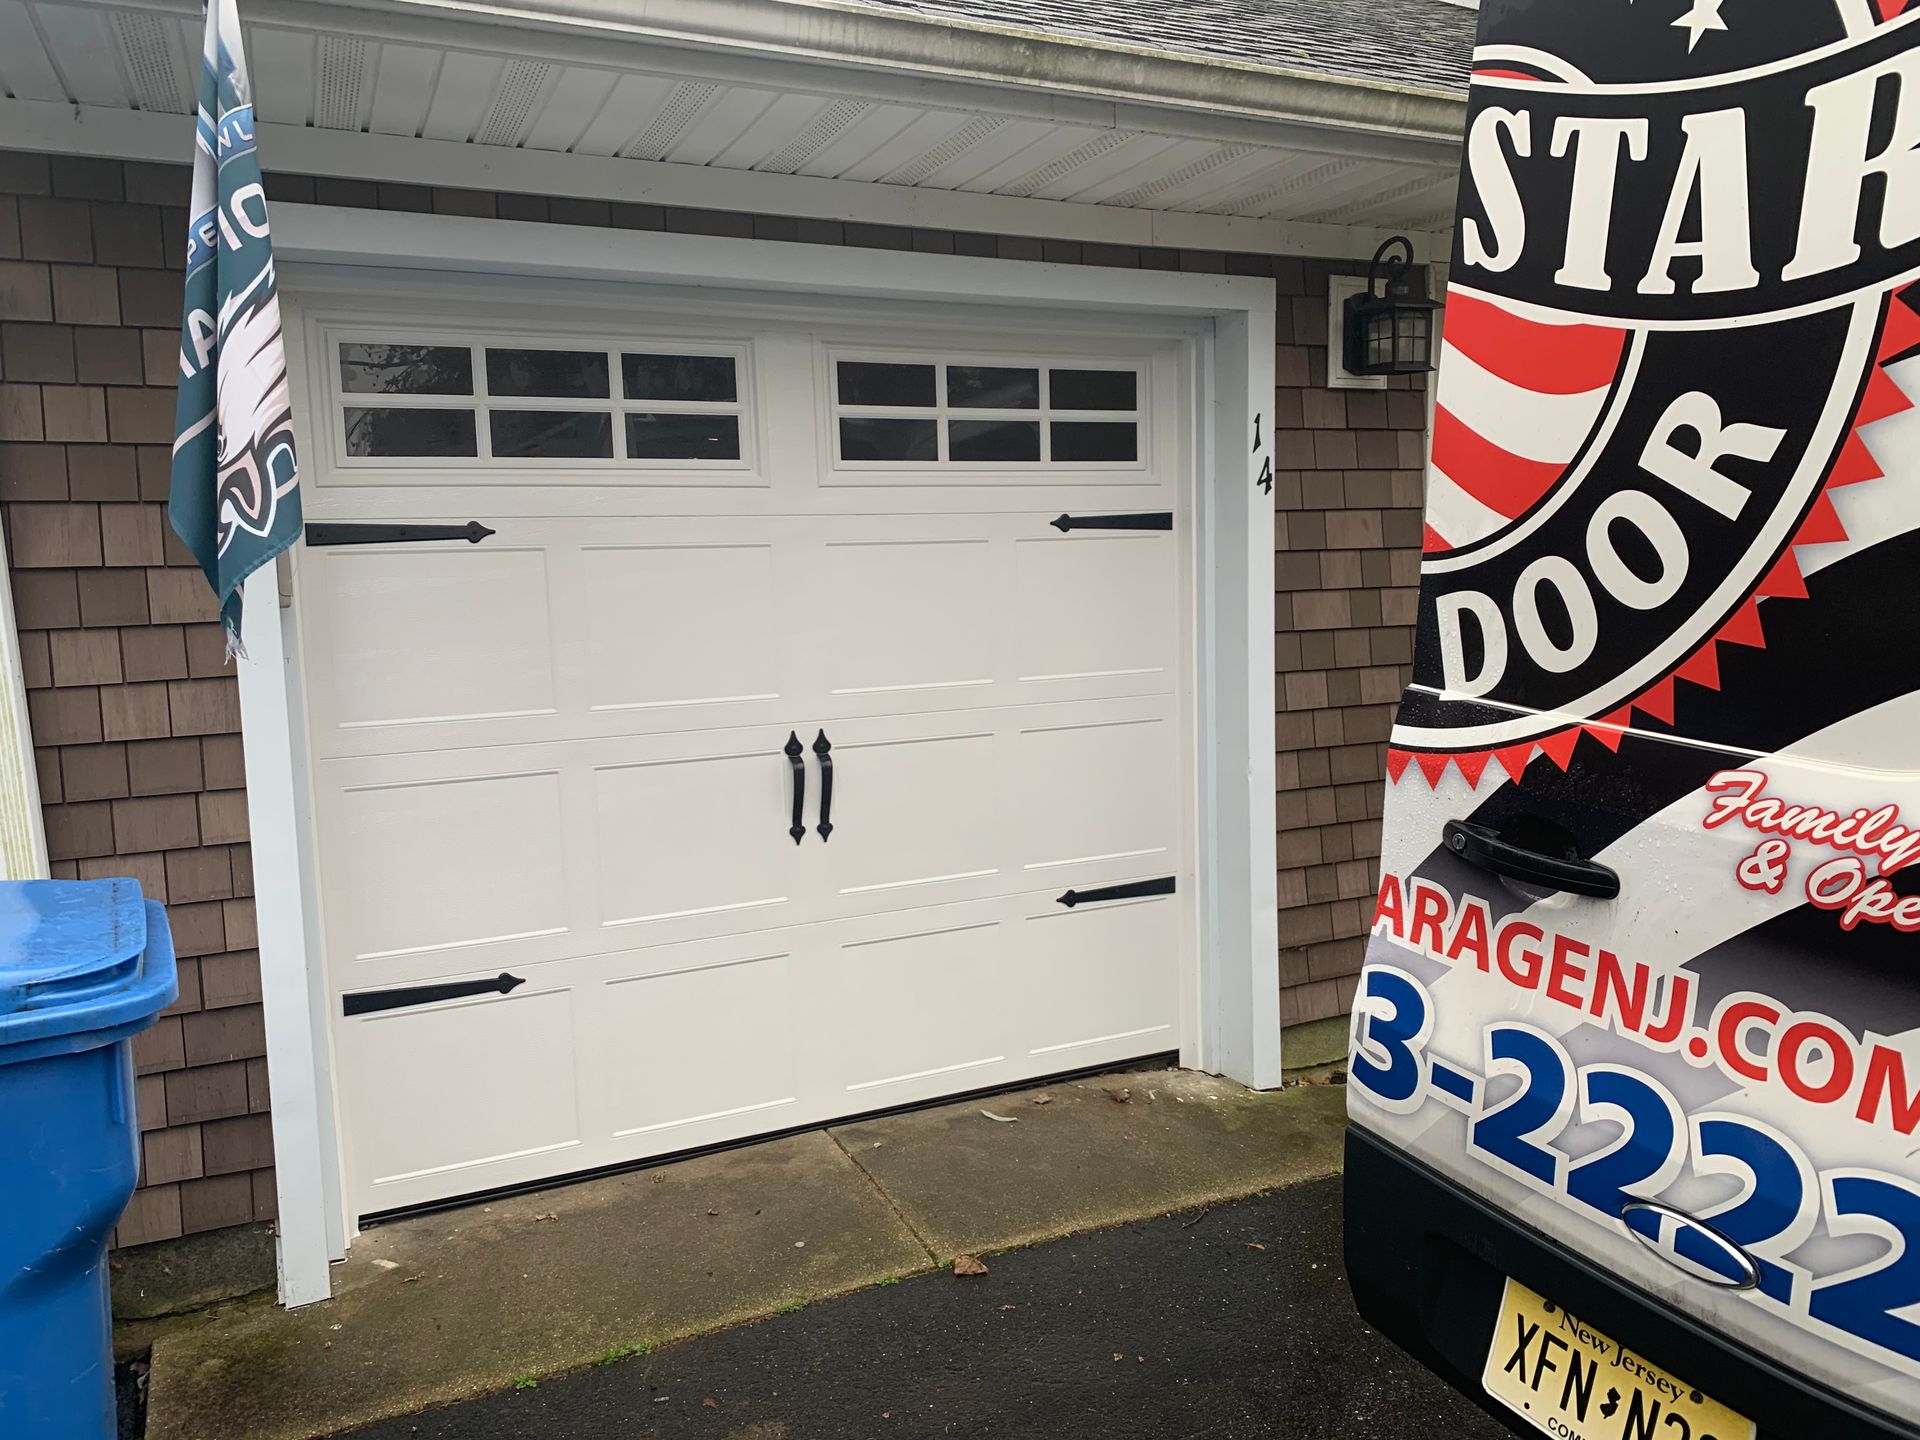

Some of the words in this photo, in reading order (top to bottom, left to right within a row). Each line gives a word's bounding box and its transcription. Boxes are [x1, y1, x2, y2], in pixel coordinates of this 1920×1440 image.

[1462, 46, 1920, 294] STAR
[1436, 391, 1788, 701] DOOR
[1736, 838, 1791, 895] &
[1558, 1312, 1611, 1355] New
[1610, 1341, 1685, 1404] Jersey
